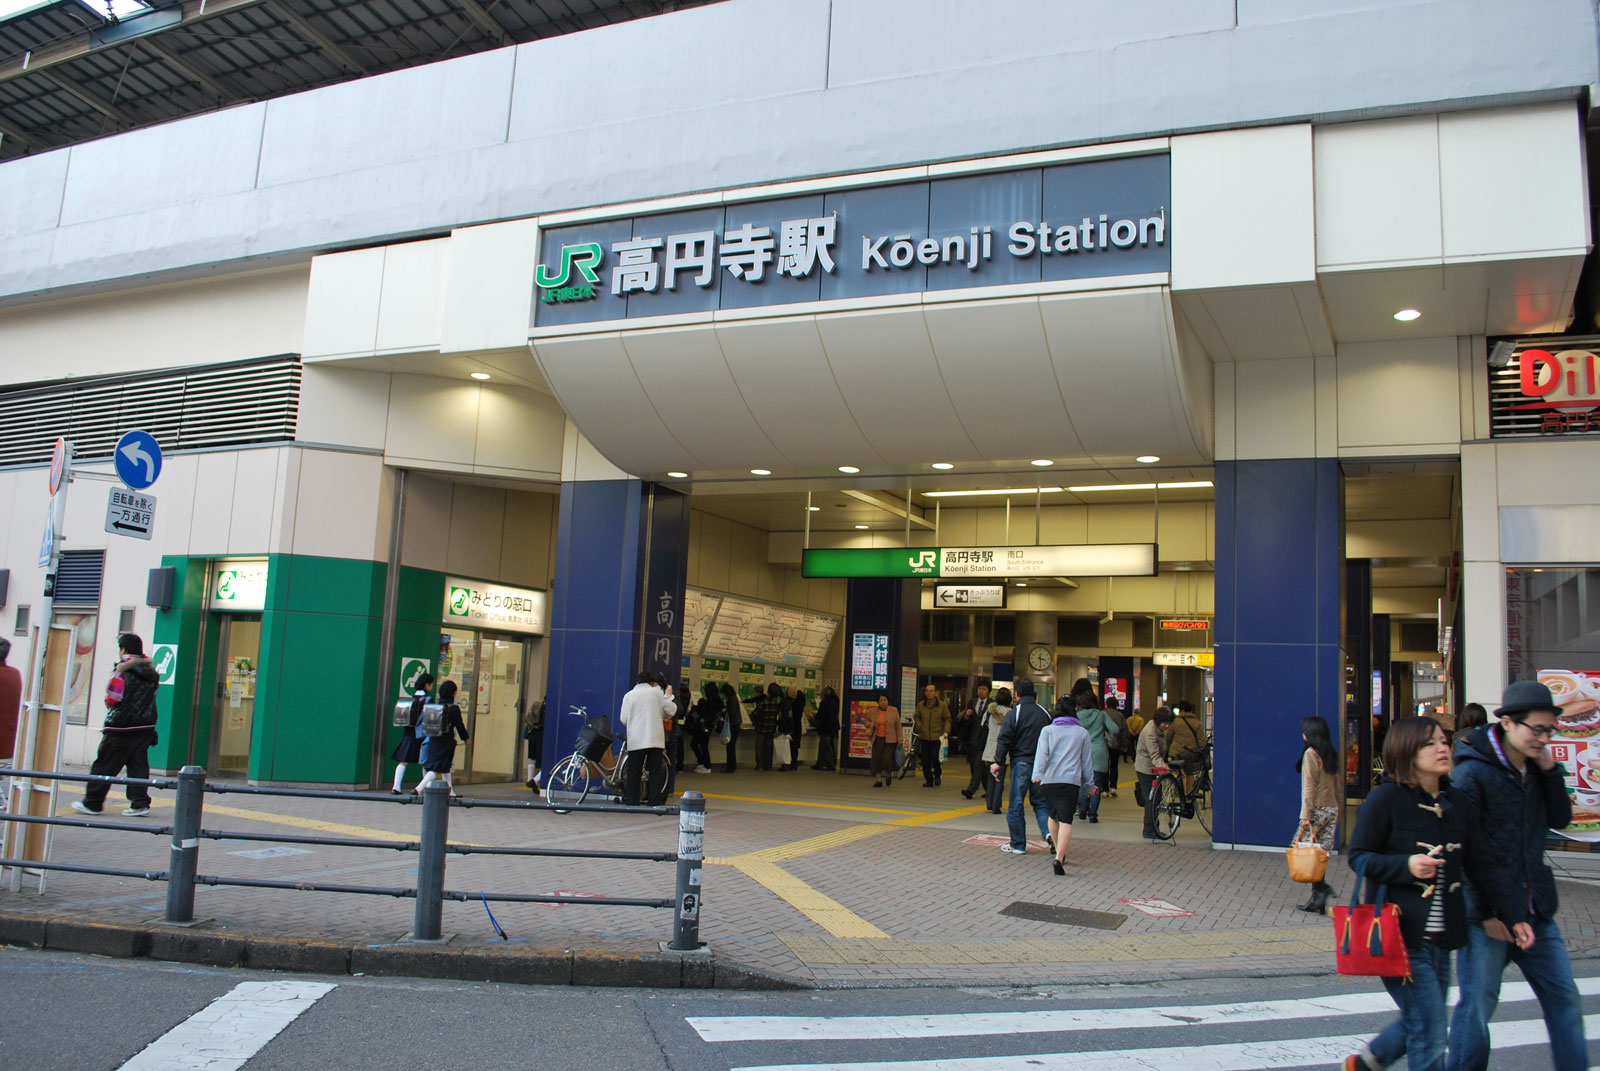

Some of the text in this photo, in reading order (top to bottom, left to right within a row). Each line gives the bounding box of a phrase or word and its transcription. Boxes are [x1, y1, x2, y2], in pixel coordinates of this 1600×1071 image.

[861, 214, 1165, 271] Kōenji Station
[535, 242, 602, 288] JR
[611, 217, 836, 296] 高円寺駅
[112, 492, 153, 511] 自転車を除く
[111, 509, 151, 525] 一方通行
[908, 551, 936, 568] JR
[945, 551, 994, 563] 高円寺駅
[1007, 550, 1024, 559] 南口
[471, 590, 532, 612] みどりの窓口
[654, 590, 674, 667] 高円
[875, 635, 888, 689] 河村眼科
[1554, 746, 1566, 758] B
